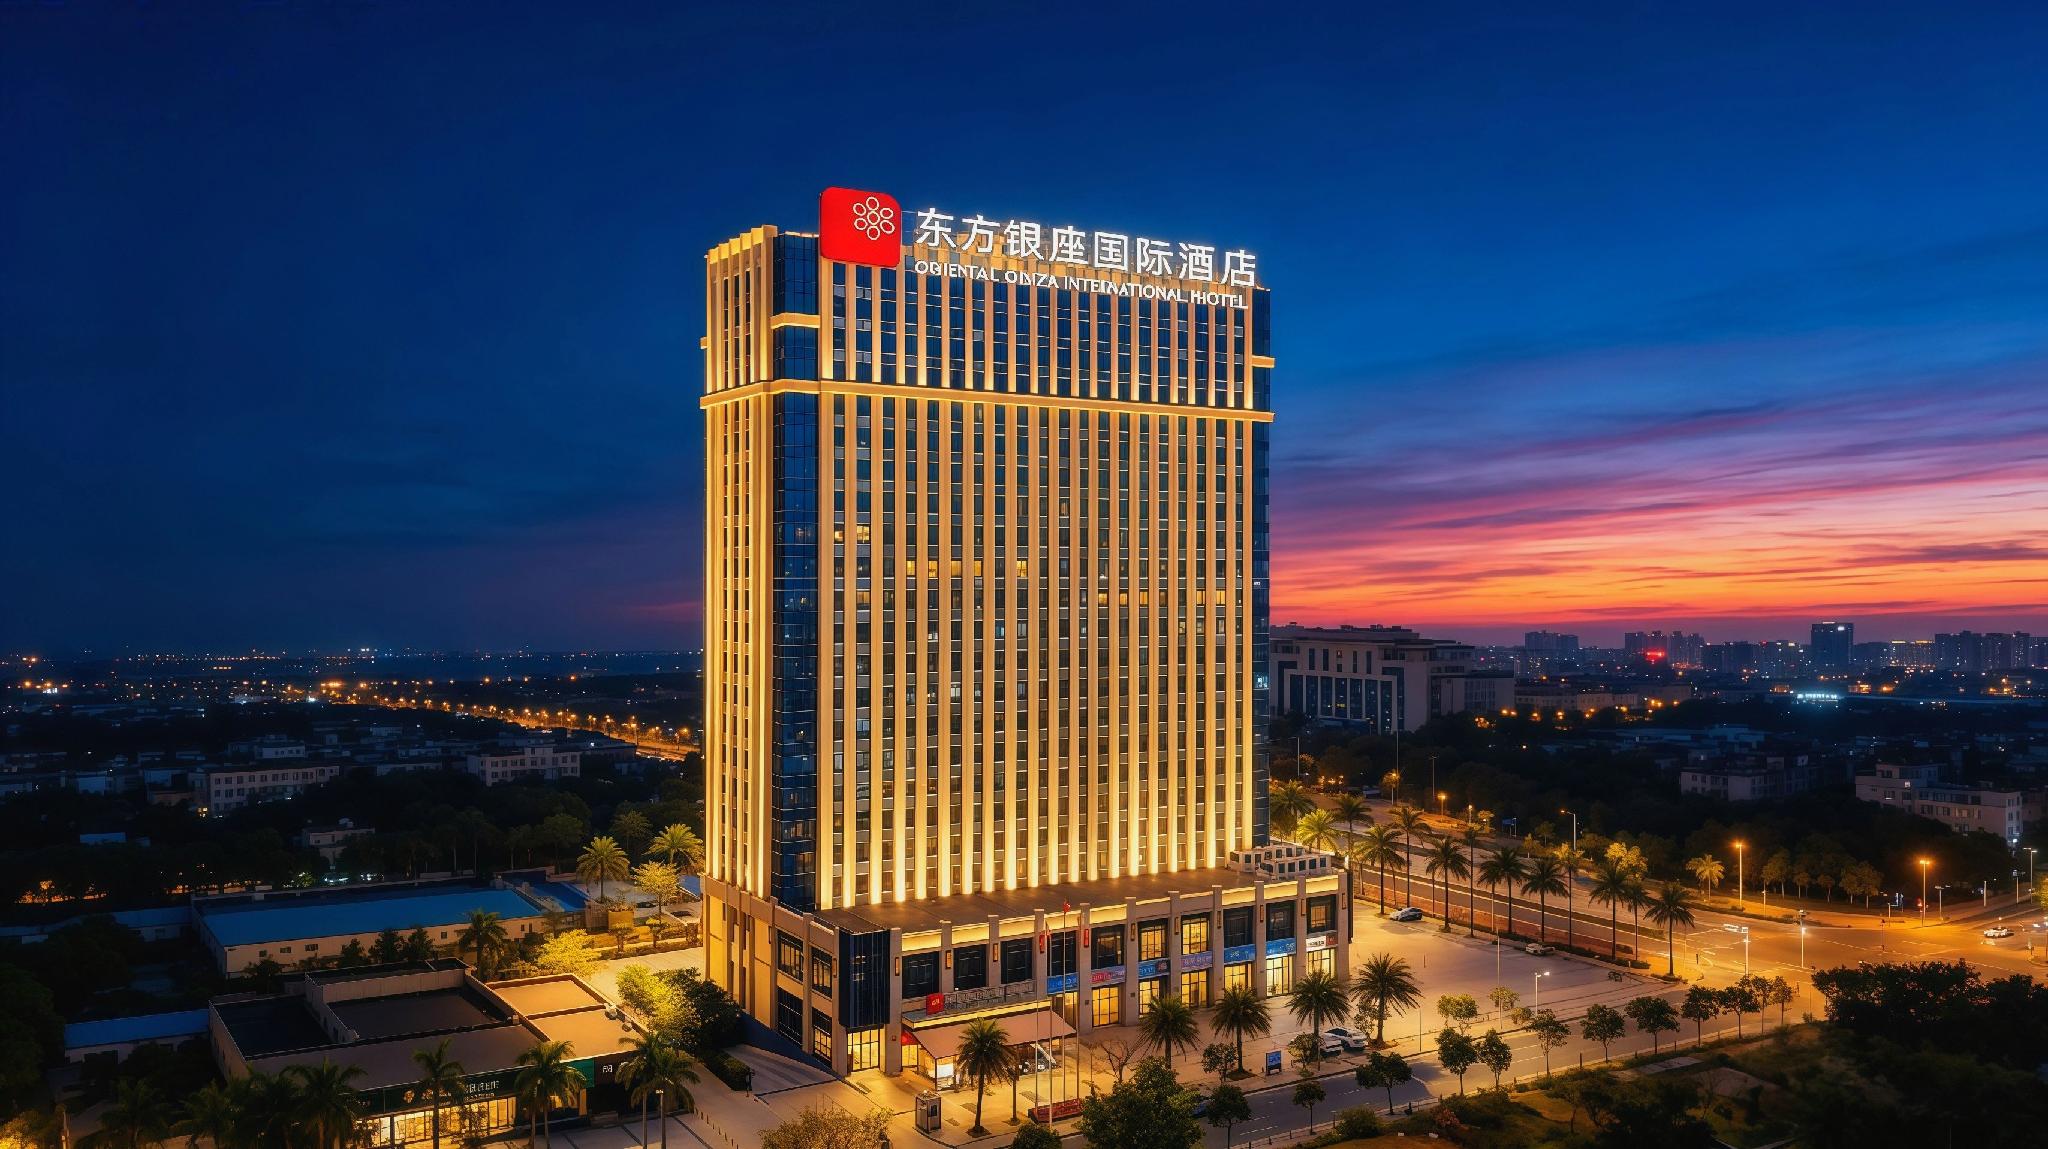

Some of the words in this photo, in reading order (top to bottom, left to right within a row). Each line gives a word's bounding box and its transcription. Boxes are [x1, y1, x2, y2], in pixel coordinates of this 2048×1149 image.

[915, 260, 999, 282] ORIENTAL
[916, 207, 1256, 287] 东方银座国际酒店
